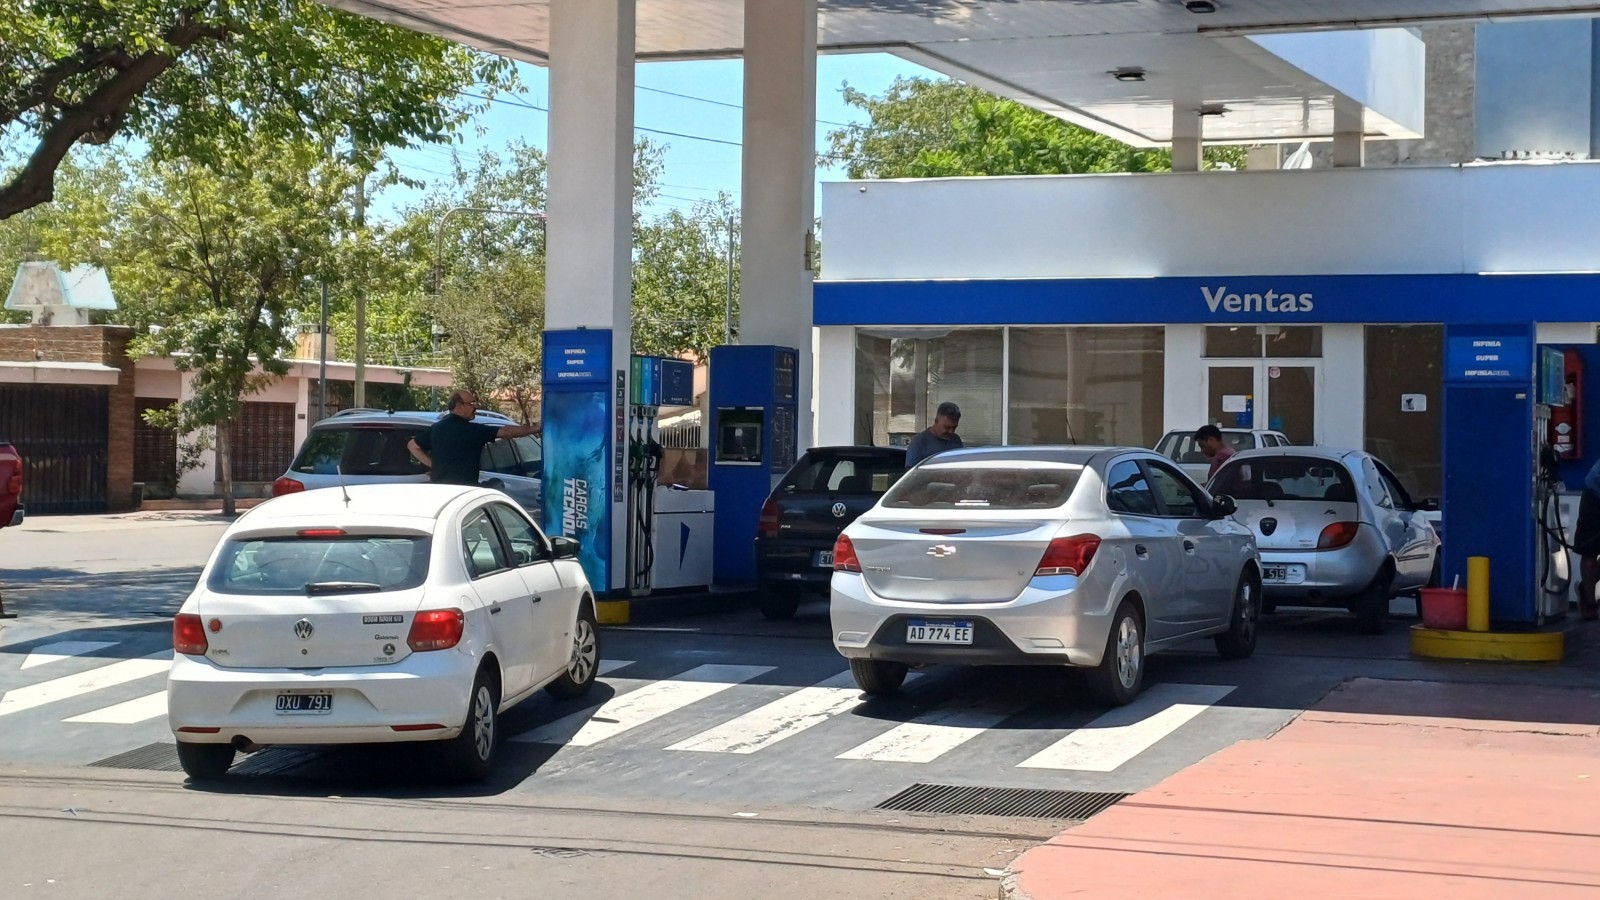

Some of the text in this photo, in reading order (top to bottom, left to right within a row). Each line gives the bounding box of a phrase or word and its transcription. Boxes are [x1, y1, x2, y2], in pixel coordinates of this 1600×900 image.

[1200, 286, 1314, 313] Ventas
[1475, 354, 1499, 362] SUPER
[575, 478, 588, 530] CARGAS
[1268, 568, 1285, 579] 519
[910, 627, 970, 641] AD 774 EE
[277, 695, 330, 710] OXU 791
